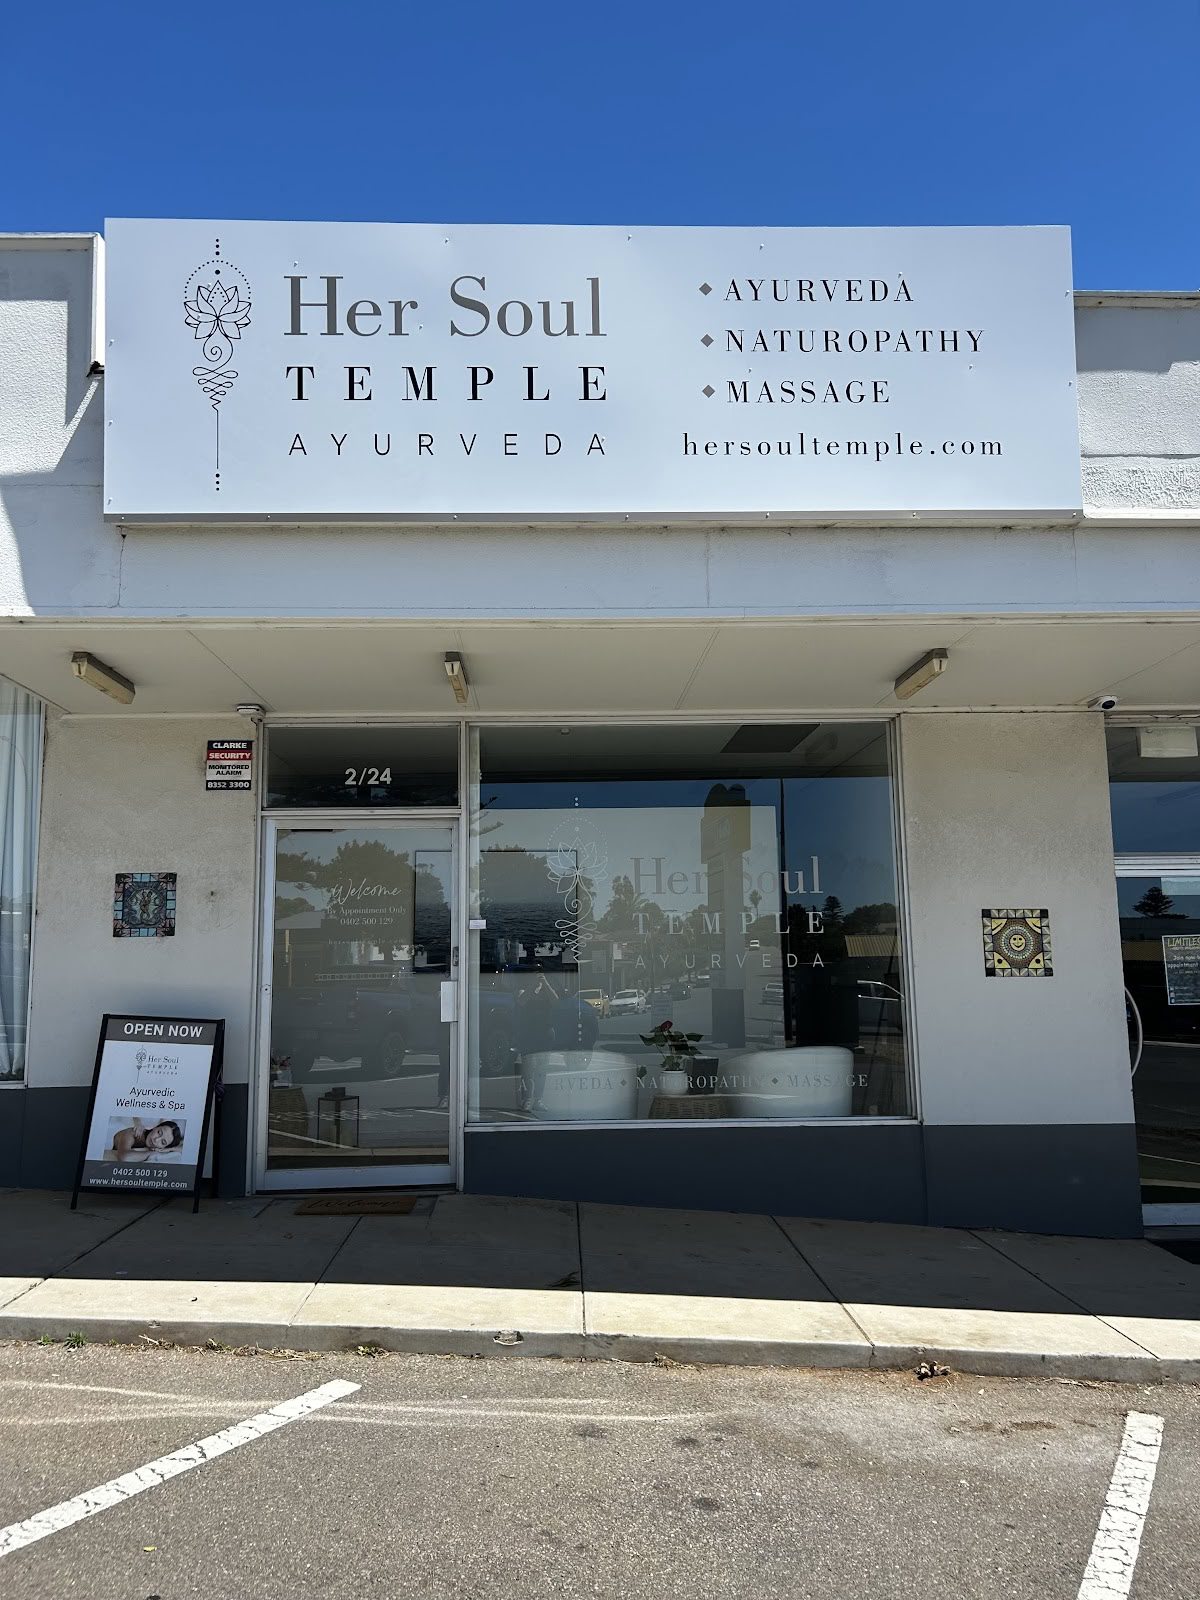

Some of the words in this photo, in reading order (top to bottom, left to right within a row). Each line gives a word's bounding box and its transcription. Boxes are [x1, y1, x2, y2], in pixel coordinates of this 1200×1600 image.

[724, 278, 914, 302] AYURVEDA
[284, 276, 418, 336] Her
[449, 275, 607, 337] Soul
[724, 329, 986, 353] NATUROPATHY
[285, 366, 607, 401] TEMPLE
[726, 380, 891, 404] MASSAGE
[288, 433, 606, 456] AYURVEDA
[682, 432, 1003, 461] hersoultemple.com
[208, 752, 251, 760] SECURITY
[207, 781, 227, 789] 8352
[229, 781, 249, 789] 3300
[344, 767, 392, 787] 2/24
[630, 857, 709, 895] Her
[333, 878, 403, 904] Welcome
[340, 906, 386, 916] Appointment
[389, 905, 406, 915] Only
[340, 917, 359, 925] 0402
[361, 917, 377, 925] 500
[632, 911, 824, 935] TEMPLE
[635, 953, 825, 969] AYURVEDA
[123, 1022, 164, 1036] OPEN
[168, 1025, 203, 1038] NOW
[148, 1055, 161, 1063] Her
[163, 1056, 179, 1064] Soul
[787, 1074, 868, 1087] MASSGE
[129, 1087, 175, 1098] Ayurvedic
[116, 1098, 157, 1109] Wellness
[160, 1100, 166, 1109] &
[168, 1101, 185, 1111] Spa
[113, 1167, 133, 1176] 0402
[136, 1168, 150, 1177] 500
[153, 1169, 168, 1178] 129
[89, 1178, 187, 1189] www.hersoultemple.com
